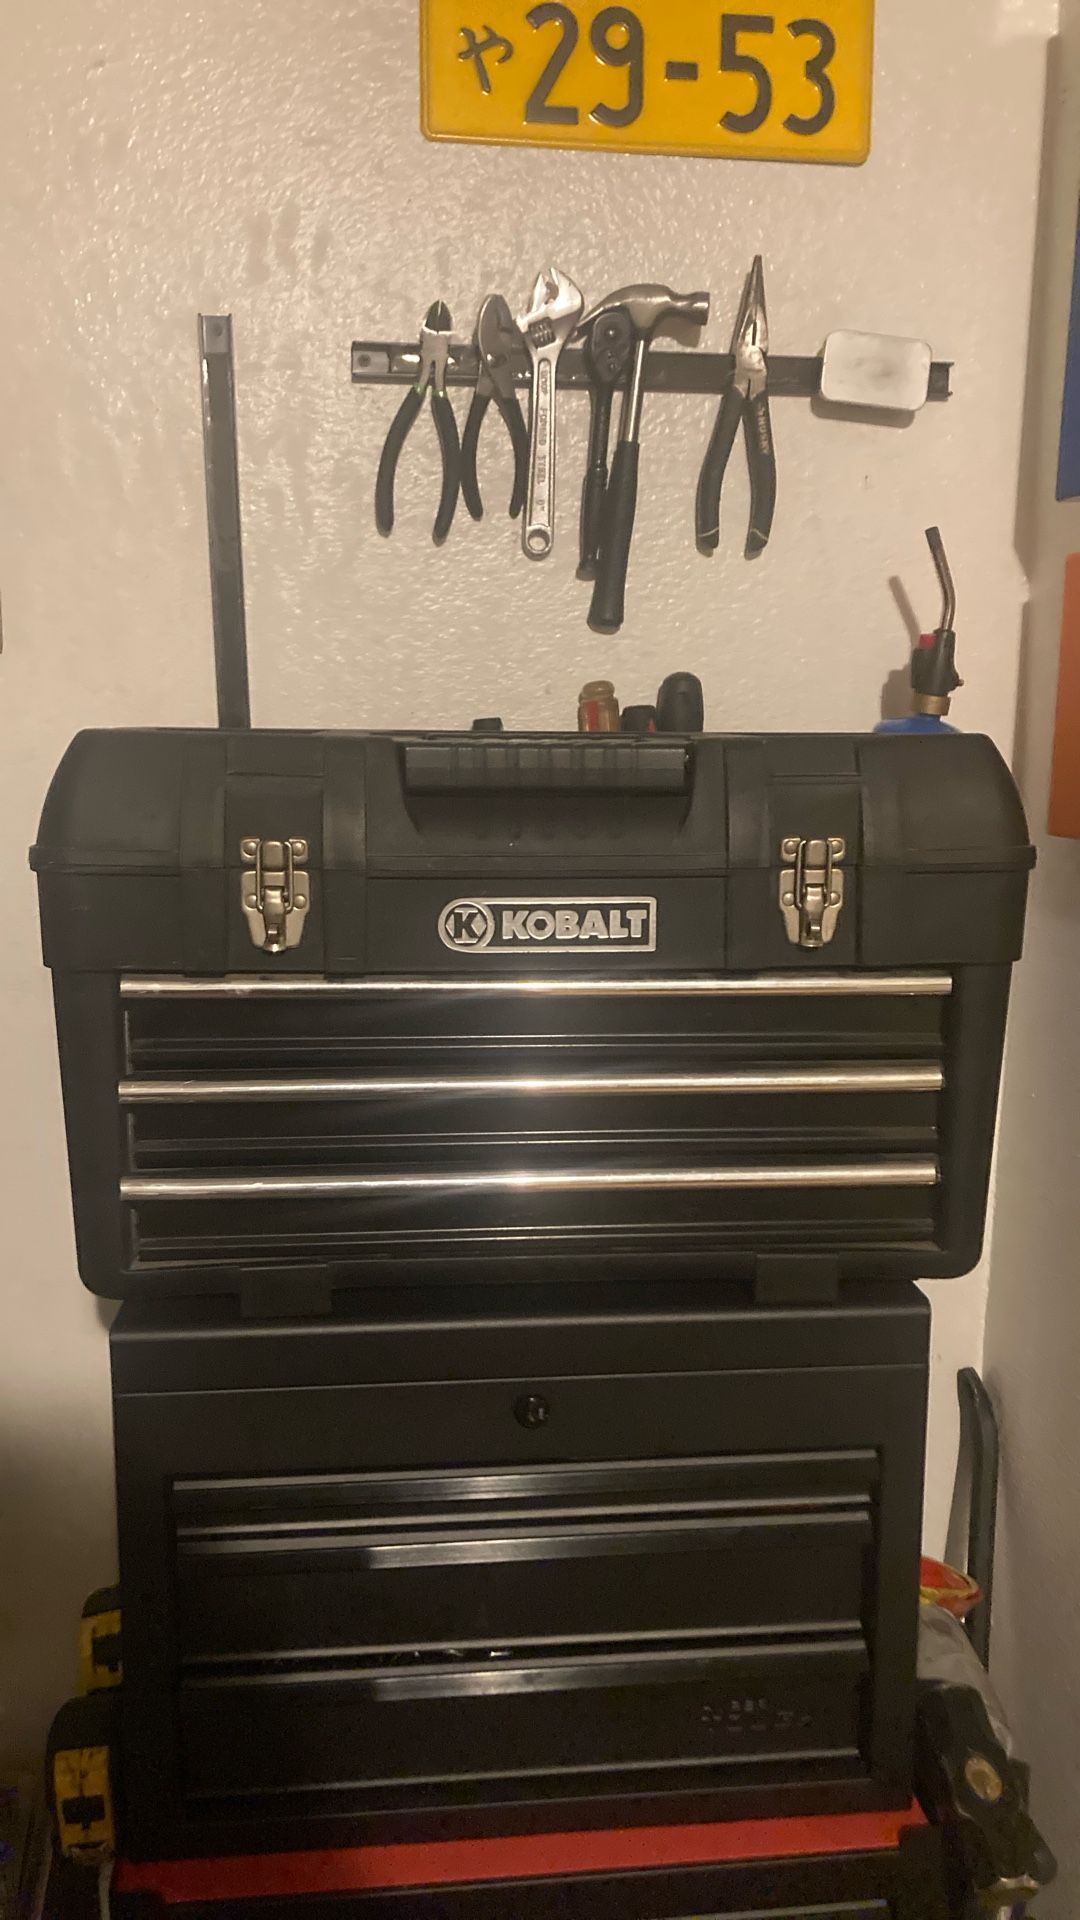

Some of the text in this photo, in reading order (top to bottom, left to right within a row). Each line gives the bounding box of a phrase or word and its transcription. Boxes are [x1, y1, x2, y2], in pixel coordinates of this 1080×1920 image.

[457, 2, 836, 136] や 29-53
[452, 909, 648, 943] K KOBALT
